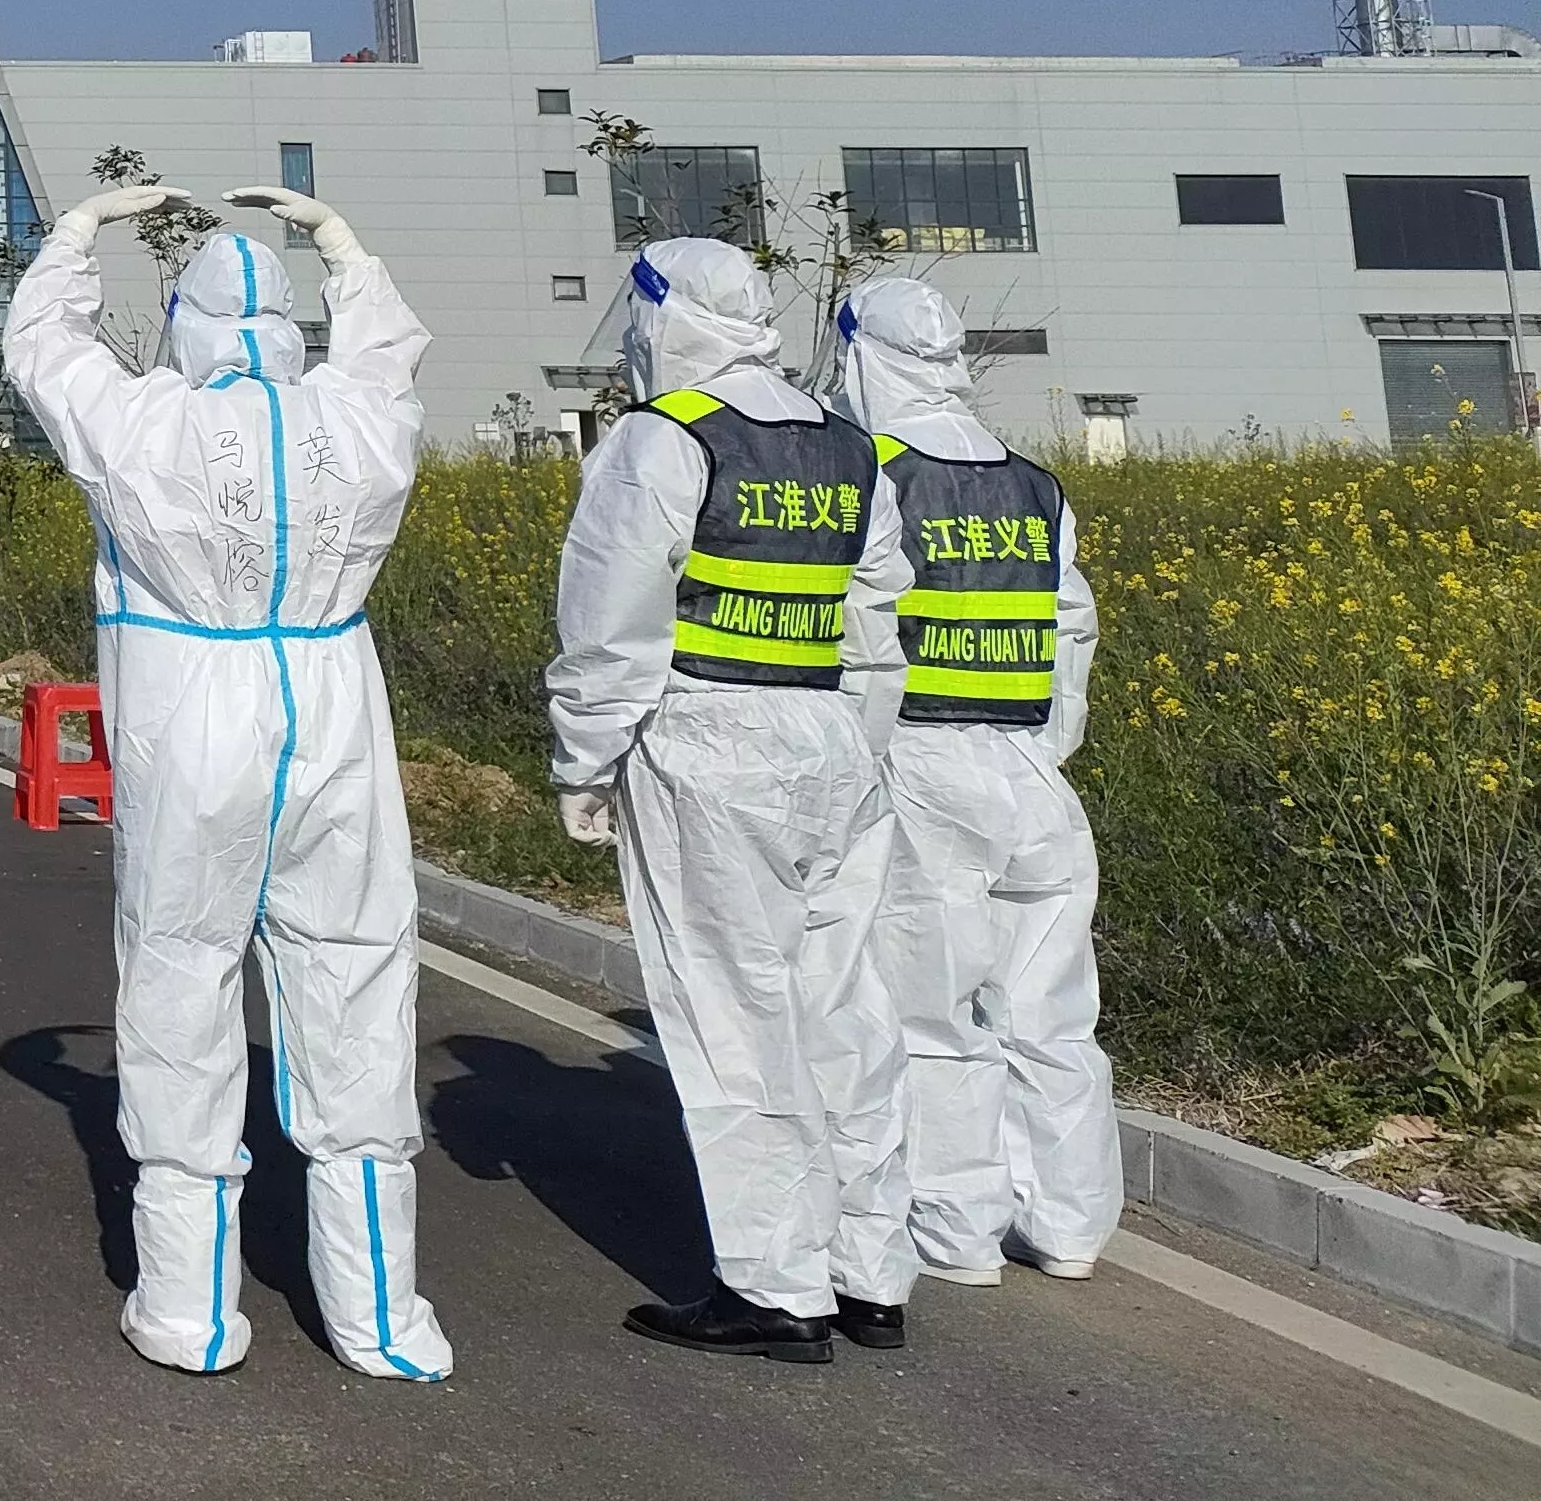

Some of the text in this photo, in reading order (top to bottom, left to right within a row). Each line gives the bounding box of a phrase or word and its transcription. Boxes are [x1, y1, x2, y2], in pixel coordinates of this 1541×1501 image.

[736, 479, 861, 534] 江淮义警
[920, 514, 1052, 562] 江淮义警
[711, 592, 774, 636] JIANG
[777, 602, 816, 638] HUAI
[818, 603, 833, 638] YI
[918, 625, 975, 662] JIANG
[980, 628, 1018, 662] HUAI
[1020, 628, 1037, 662] YI
